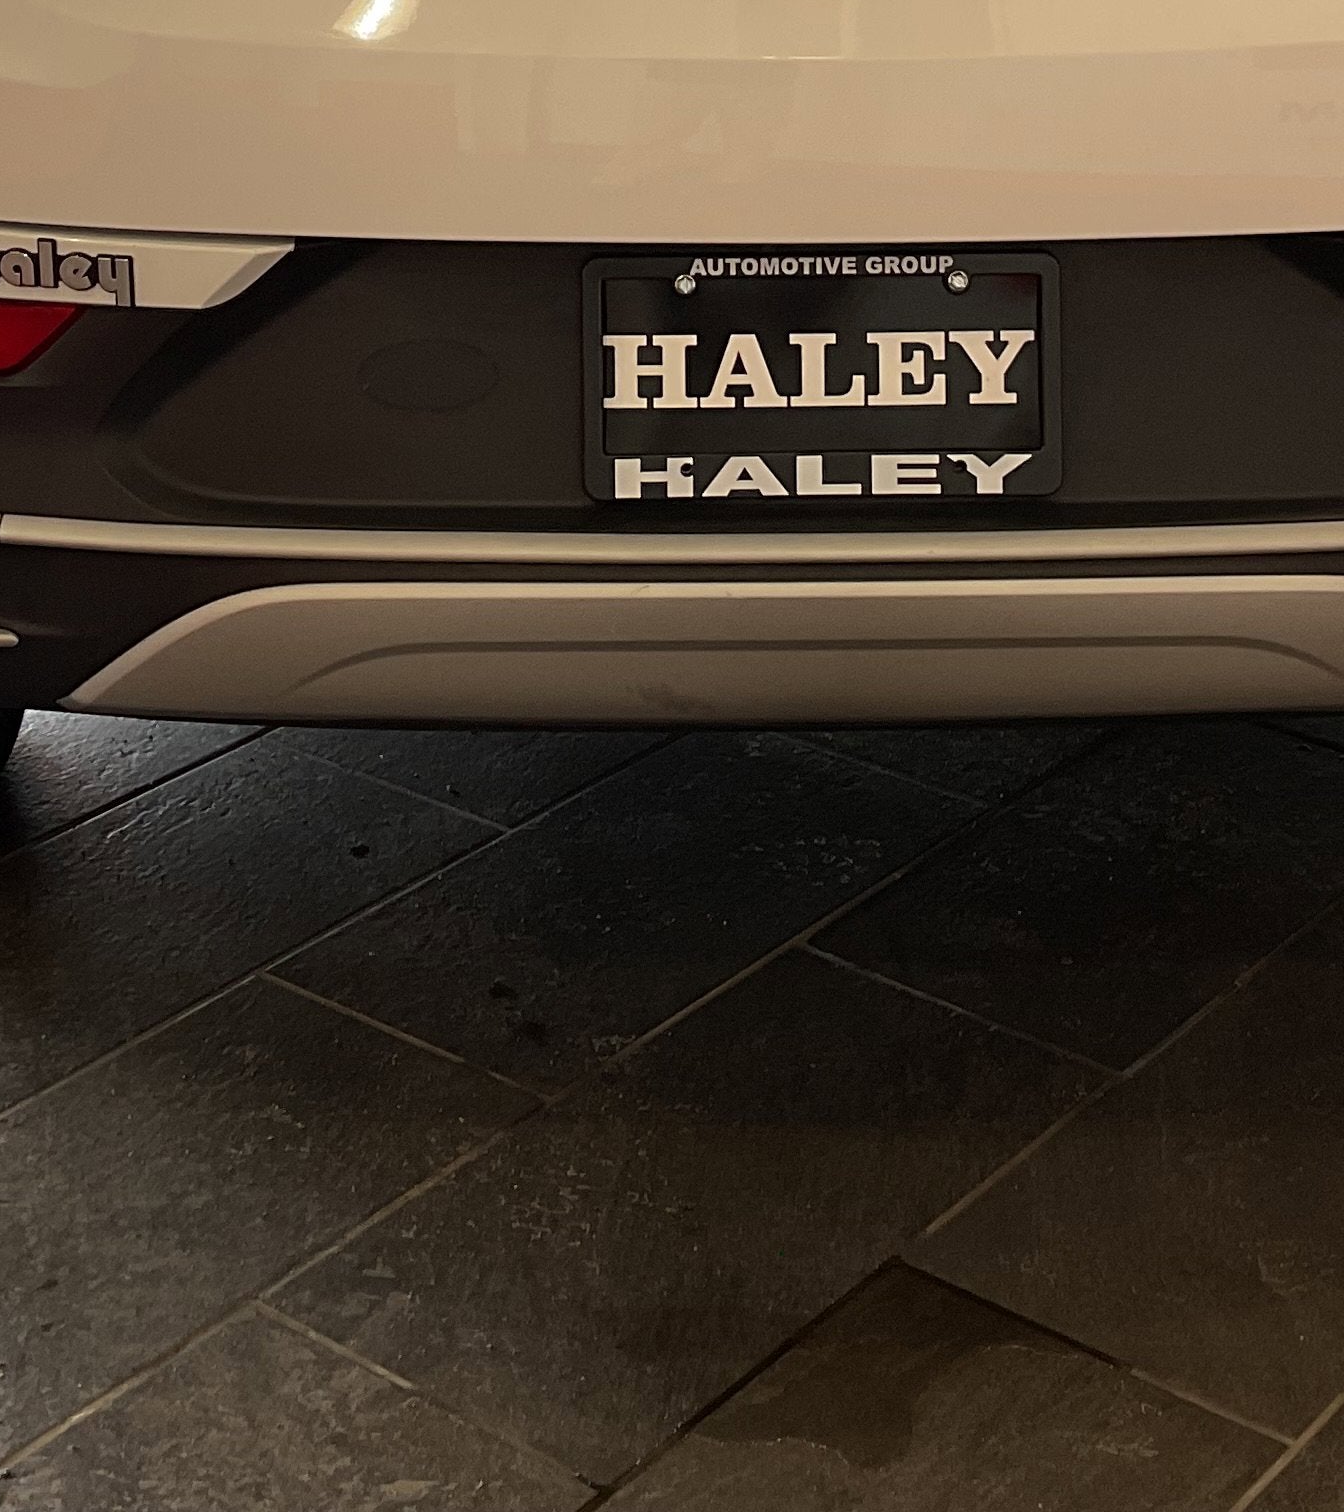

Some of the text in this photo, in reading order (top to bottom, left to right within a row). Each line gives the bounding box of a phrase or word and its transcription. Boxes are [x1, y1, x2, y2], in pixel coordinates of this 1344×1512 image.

[689, 255, 954, 277] AUTOMOTIVE GROUP
[602, 329, 1036, 410] HALEY
[613, 452, 1033, 500] HALEY
